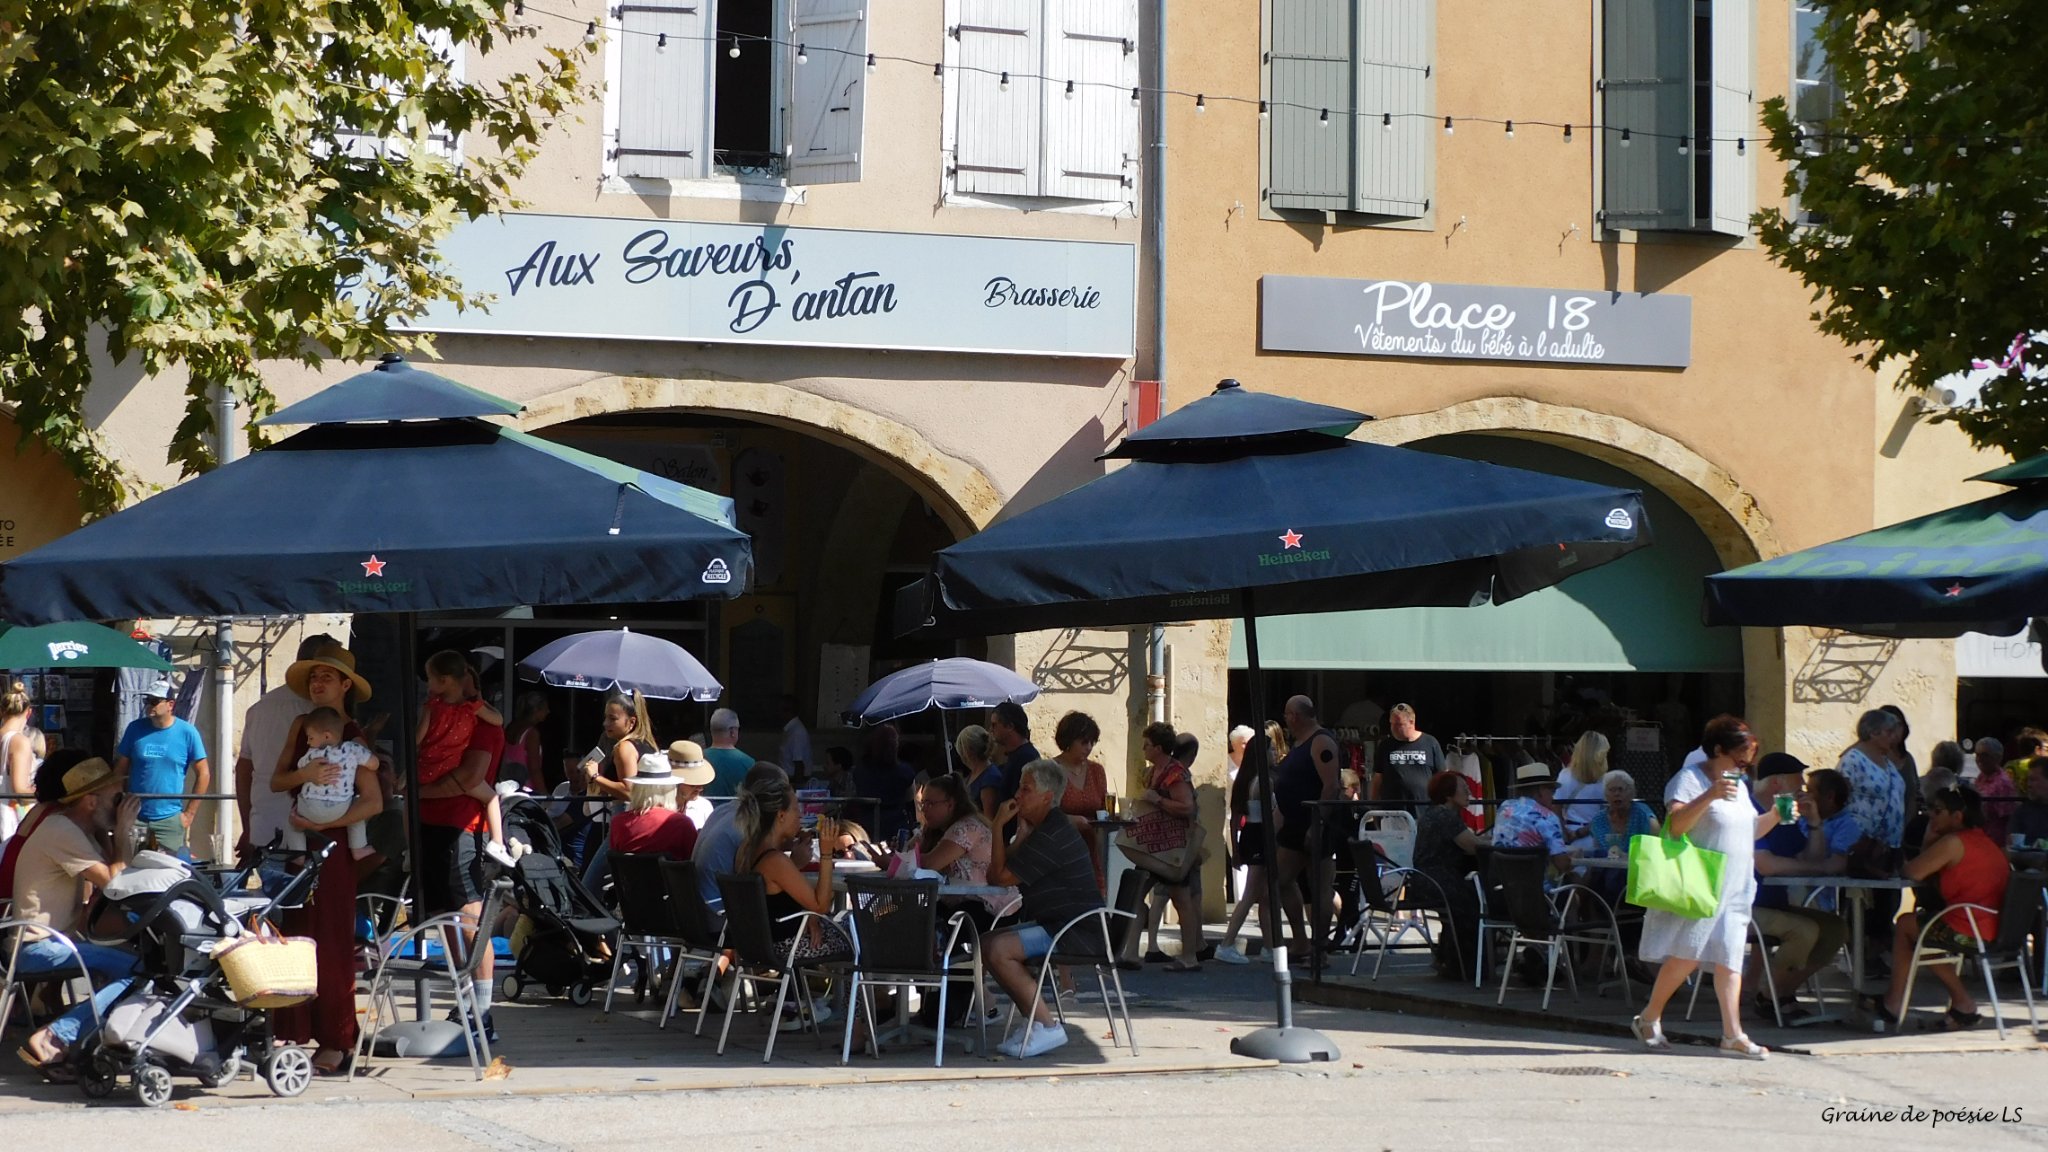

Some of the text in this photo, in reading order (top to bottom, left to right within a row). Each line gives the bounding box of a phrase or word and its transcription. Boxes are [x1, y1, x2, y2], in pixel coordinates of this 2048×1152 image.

[505, 229, 795, 296] Aux Saveurs
[728, 269, 898, 334] D'antan
[983, 276, 1101, 309] Brasserie
[1363, 280, 1597, 331] Place 18
[1354, 323, 1447, 354] Vêtements
[1451, 326, 1476, 355] du
[1481, 328, 1515, 357] bébé
[1518, 336, 1533, 357] à
[1258, 548, 1331, 567] Heineken
[1390, 753, 1426, 761] BENETTON
